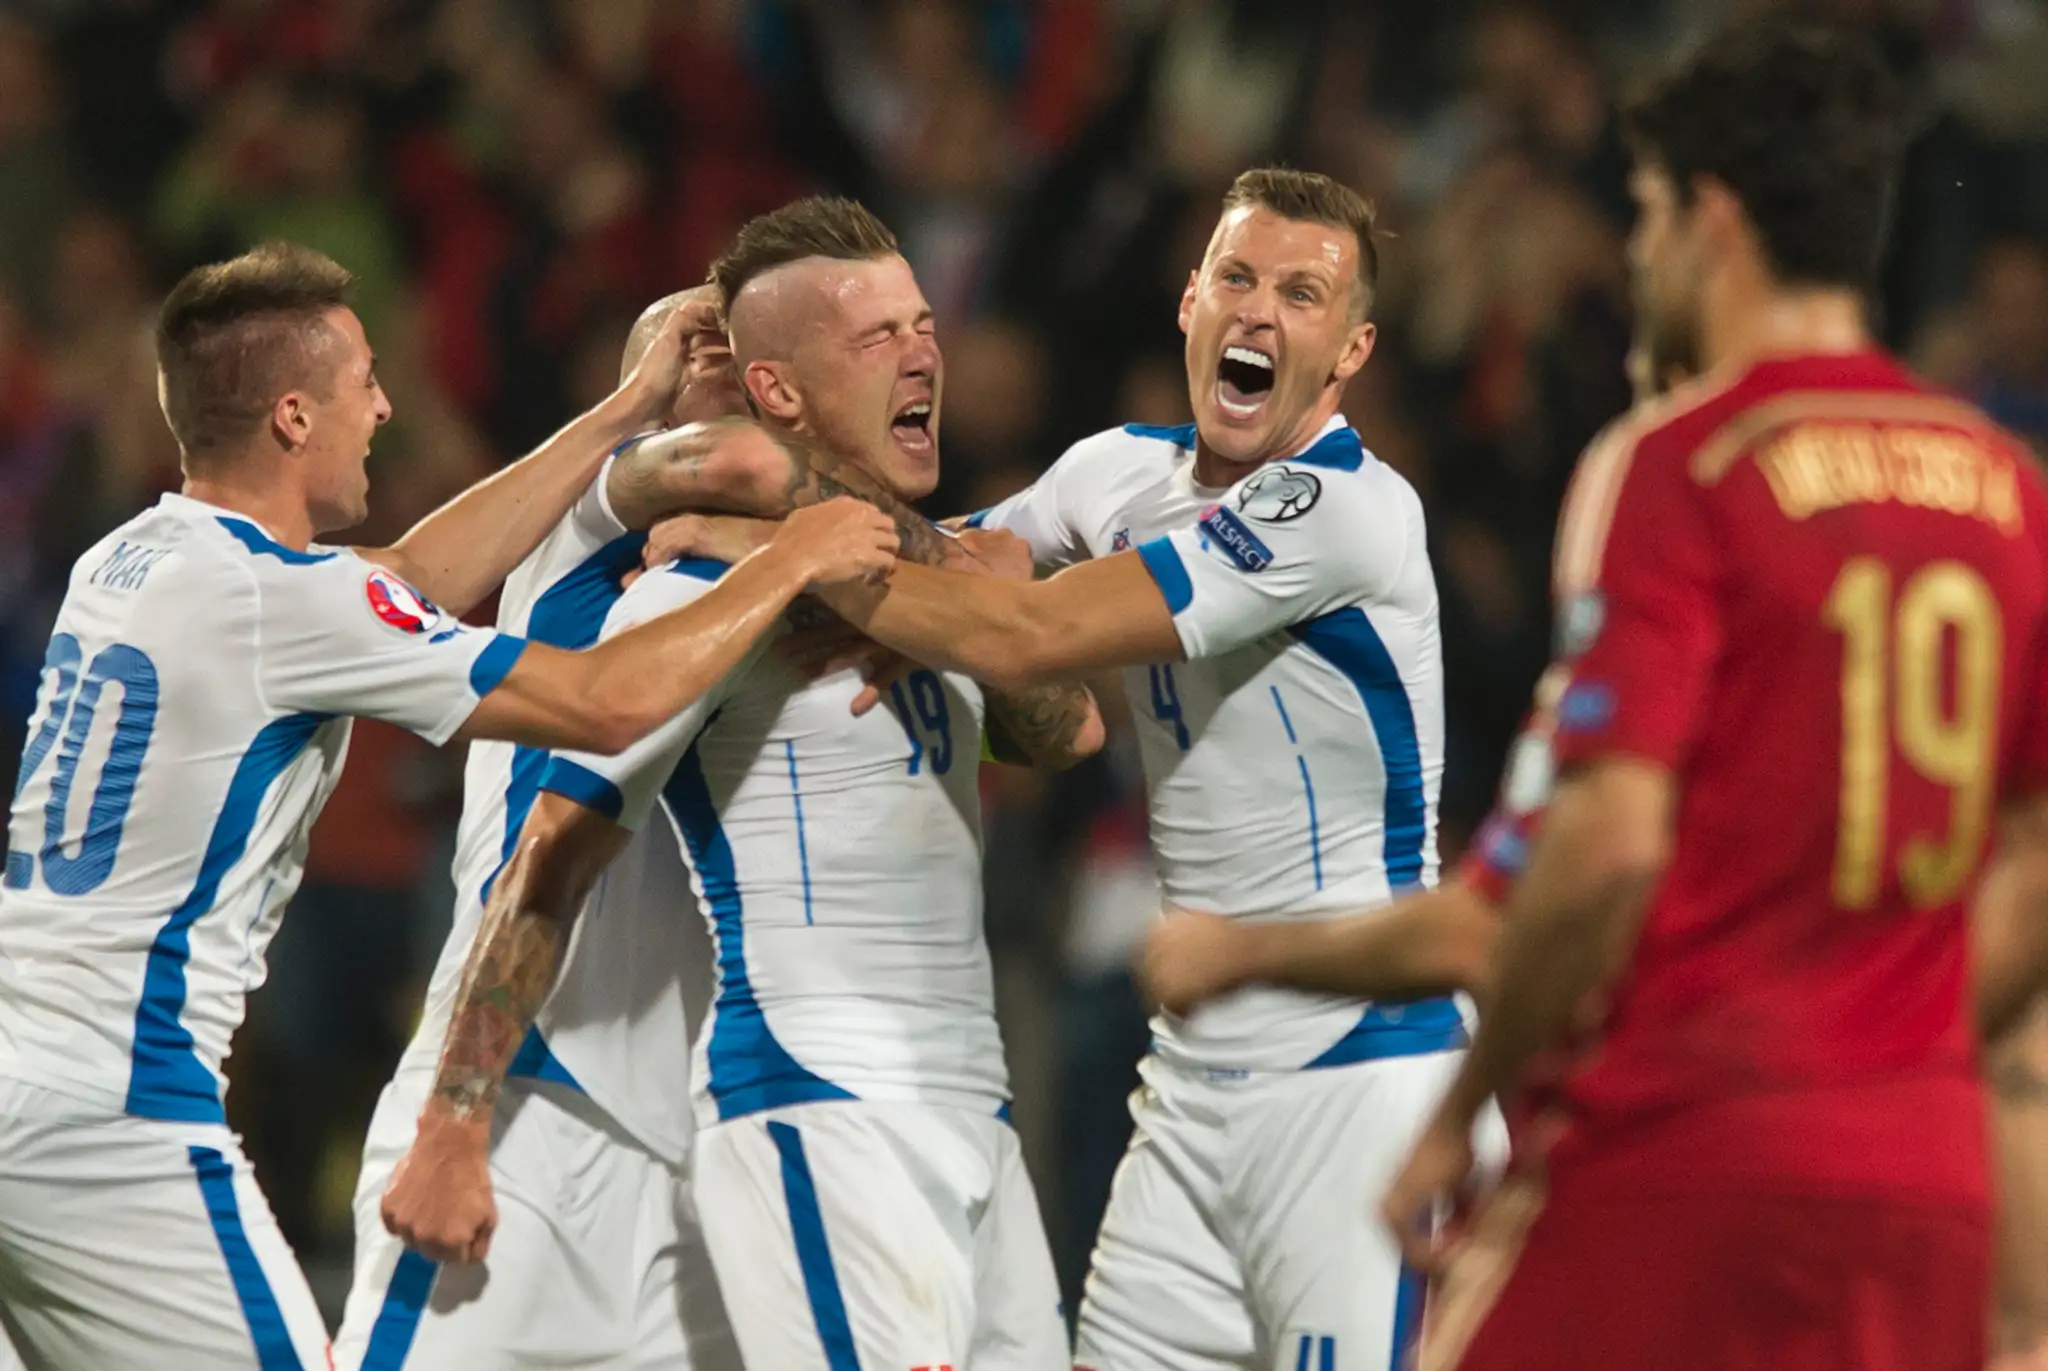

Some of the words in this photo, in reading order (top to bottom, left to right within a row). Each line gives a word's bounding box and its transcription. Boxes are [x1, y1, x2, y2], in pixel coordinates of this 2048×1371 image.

[1209, 512, 1267, 569] RESPECT
[891, 669, 952, 776] 19
[1149, 663, 1191, 751] 4
[1823, 556, 2002, 905] 19
